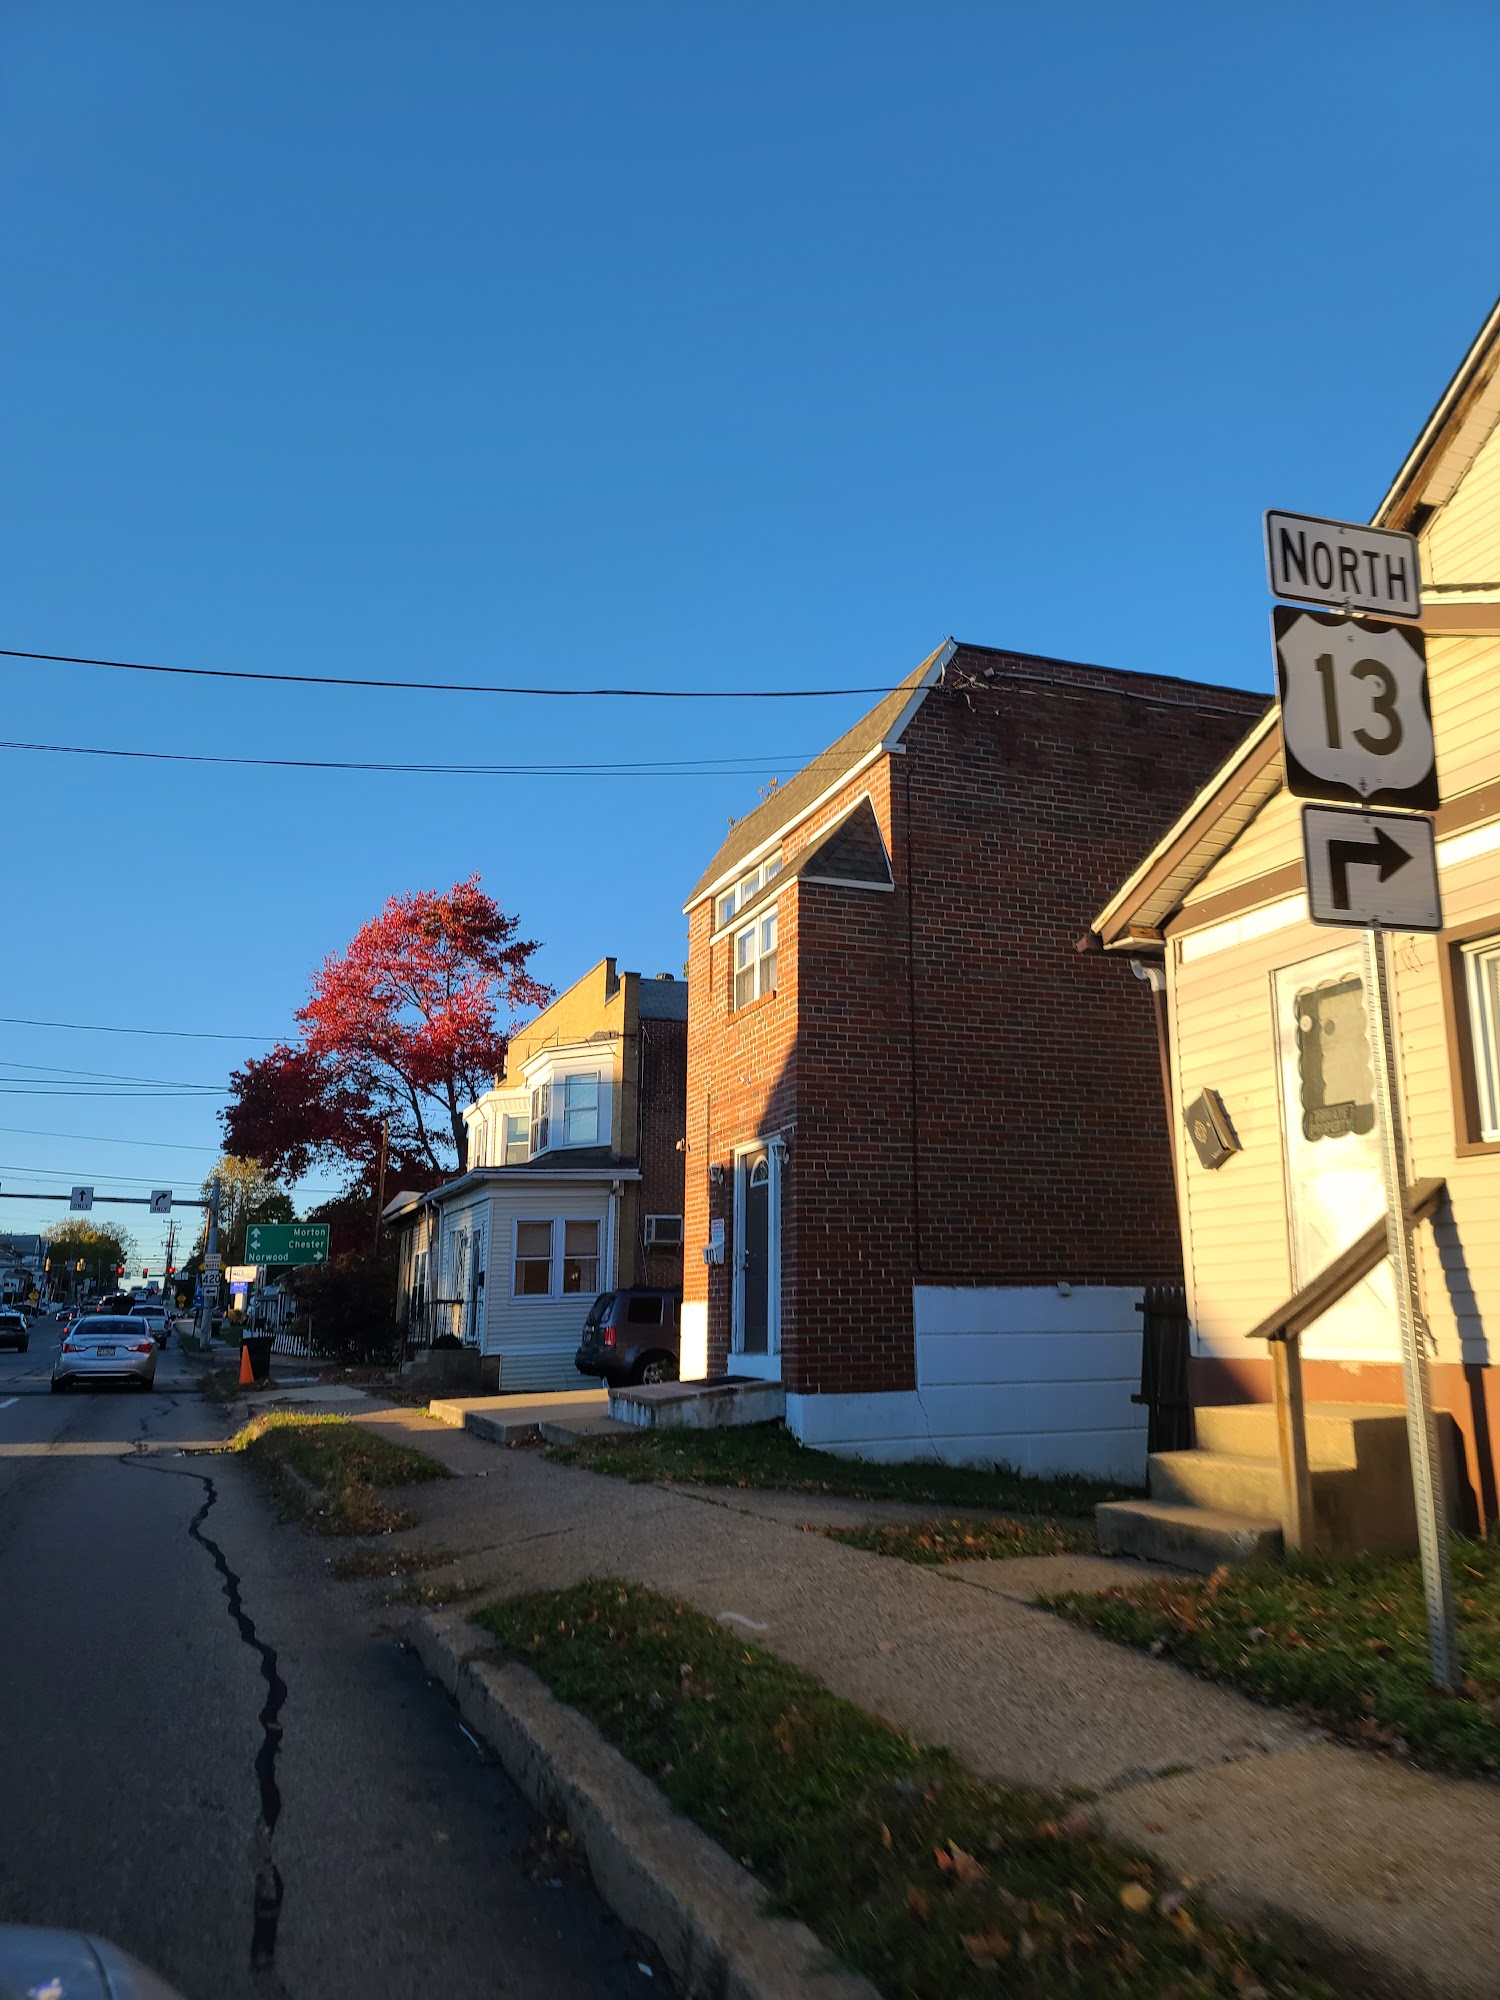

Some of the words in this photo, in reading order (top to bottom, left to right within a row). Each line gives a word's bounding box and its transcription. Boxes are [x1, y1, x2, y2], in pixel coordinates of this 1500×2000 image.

[1279, 527, 1408, 602] NORTH
[1314, 653, 1404, 756] 13
[293, 1228, 326, 1236] Morton
[288, 1240, 325, 1248] Chester
[248, 1252, 289, 1262] Norwood
[202, 1274, 221, 1284] 420
